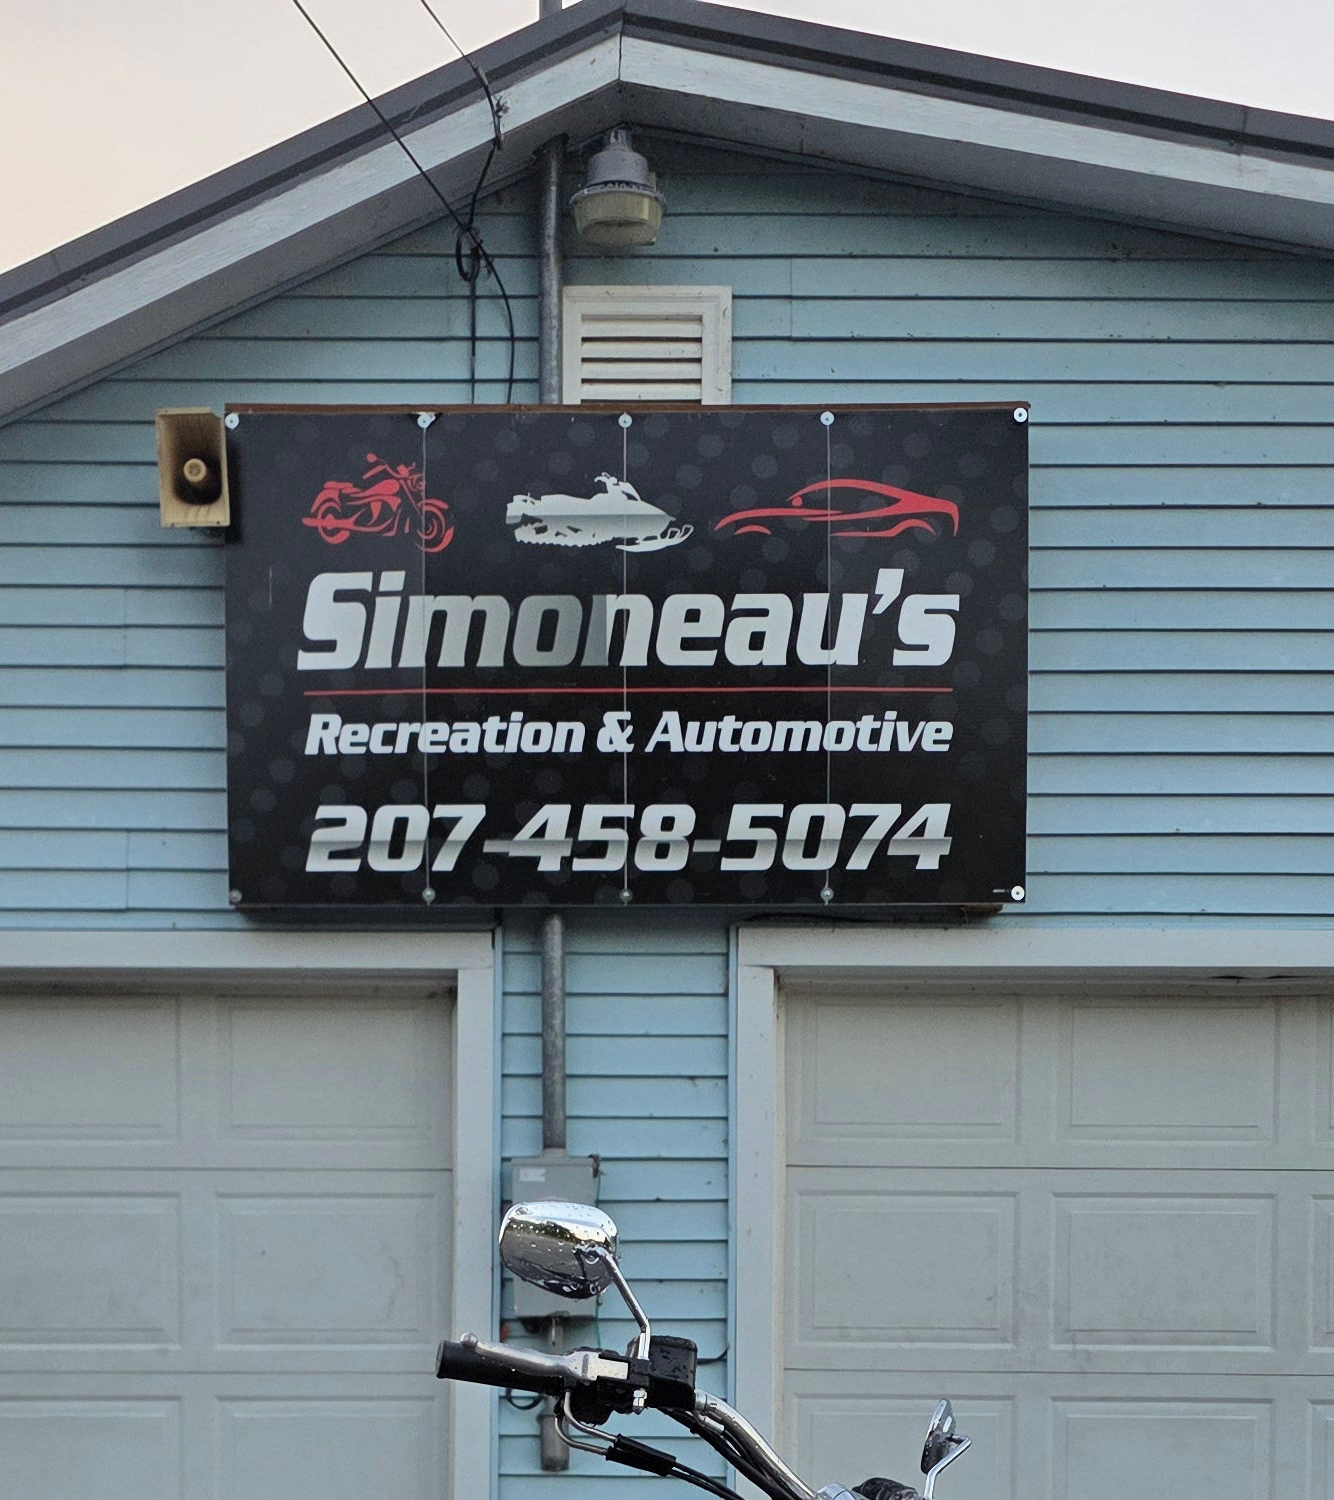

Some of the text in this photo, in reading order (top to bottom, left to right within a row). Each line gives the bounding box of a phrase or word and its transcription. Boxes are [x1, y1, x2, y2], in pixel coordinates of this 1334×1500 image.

[297, 568, 960, 670] Simoneau's
[304, 710, 954, 755] Recreation & Automotive
[305, 803, 953, 873] 207-458-5074
